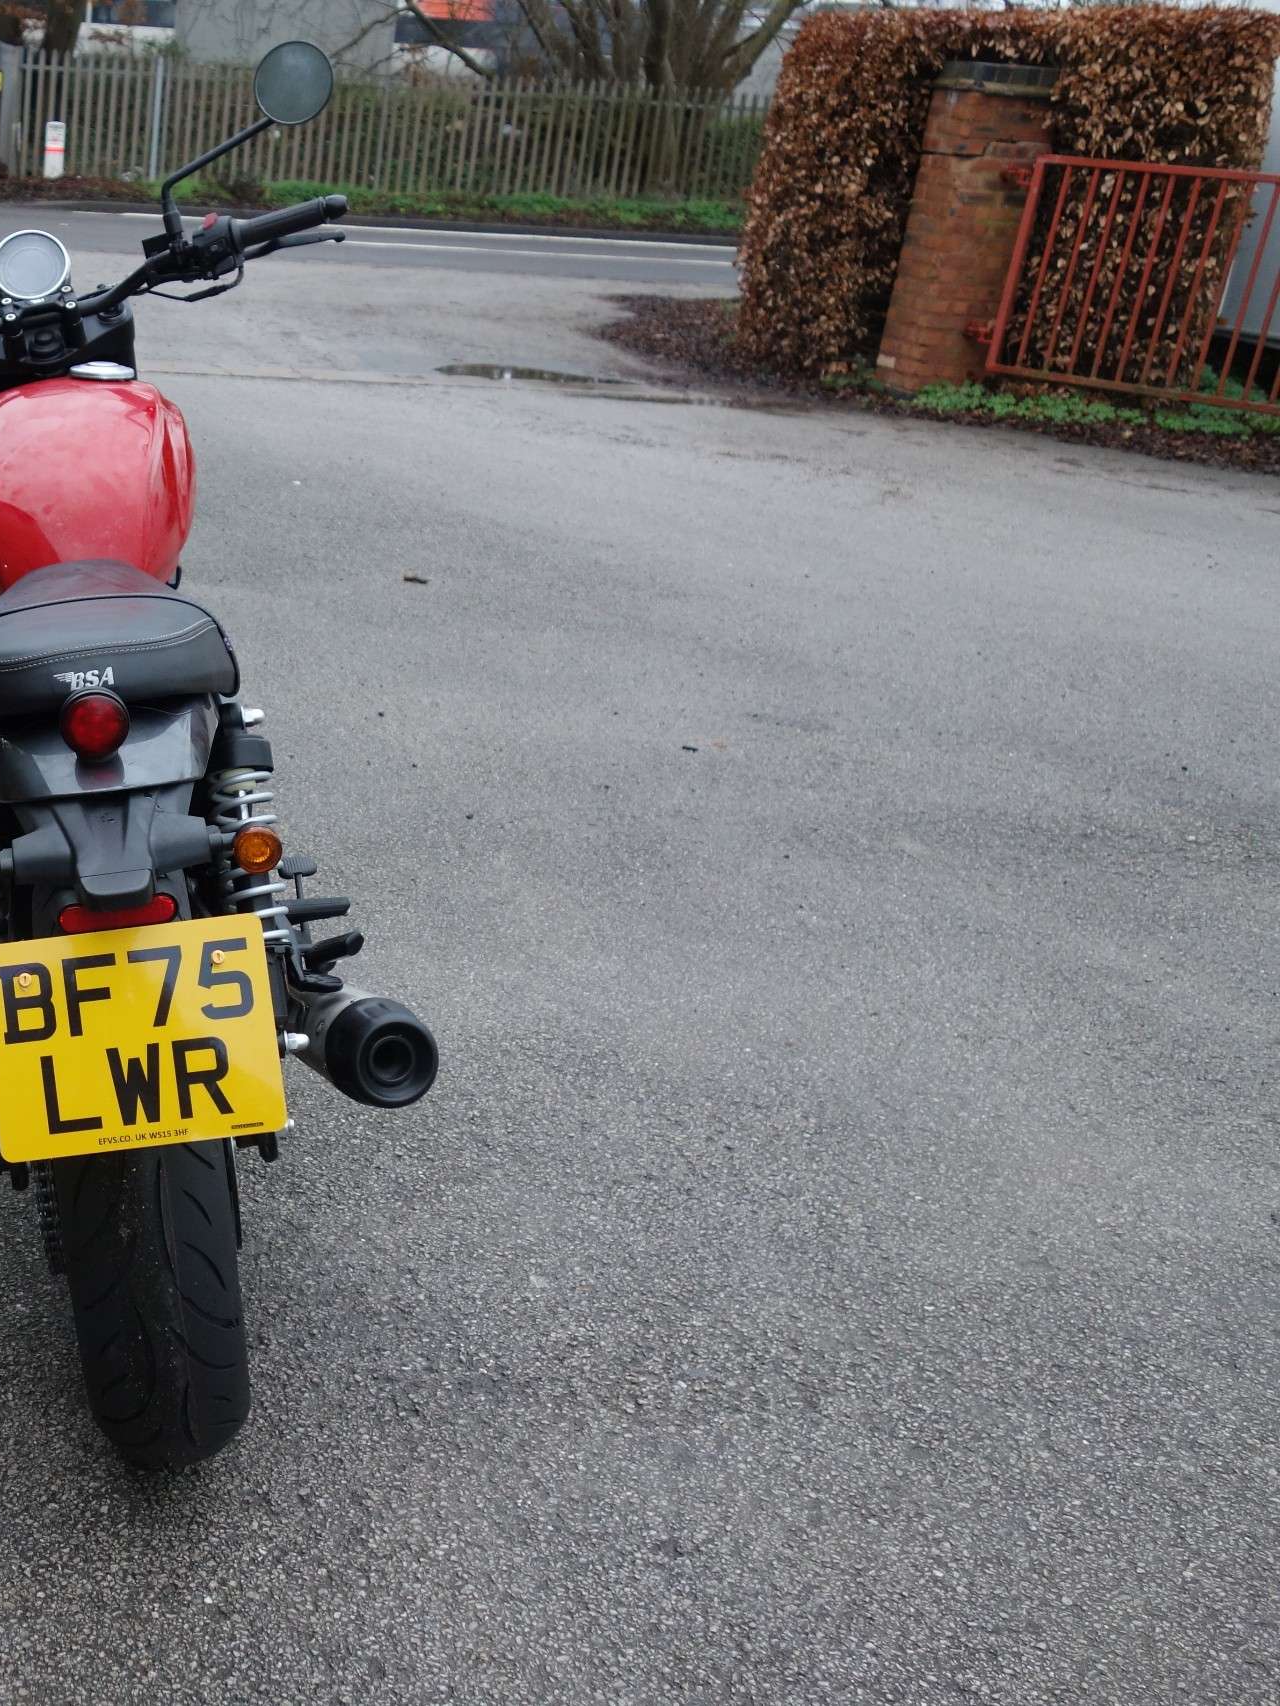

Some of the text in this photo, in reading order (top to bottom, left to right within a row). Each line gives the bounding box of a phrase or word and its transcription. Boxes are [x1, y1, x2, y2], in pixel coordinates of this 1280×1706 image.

[70, 666, 115, 691] BSA
[40, 1036, 235, 1135] LWR
[135, 1133, 146, 1141] UK
[174, 1128, 189, 1136] 3HF
